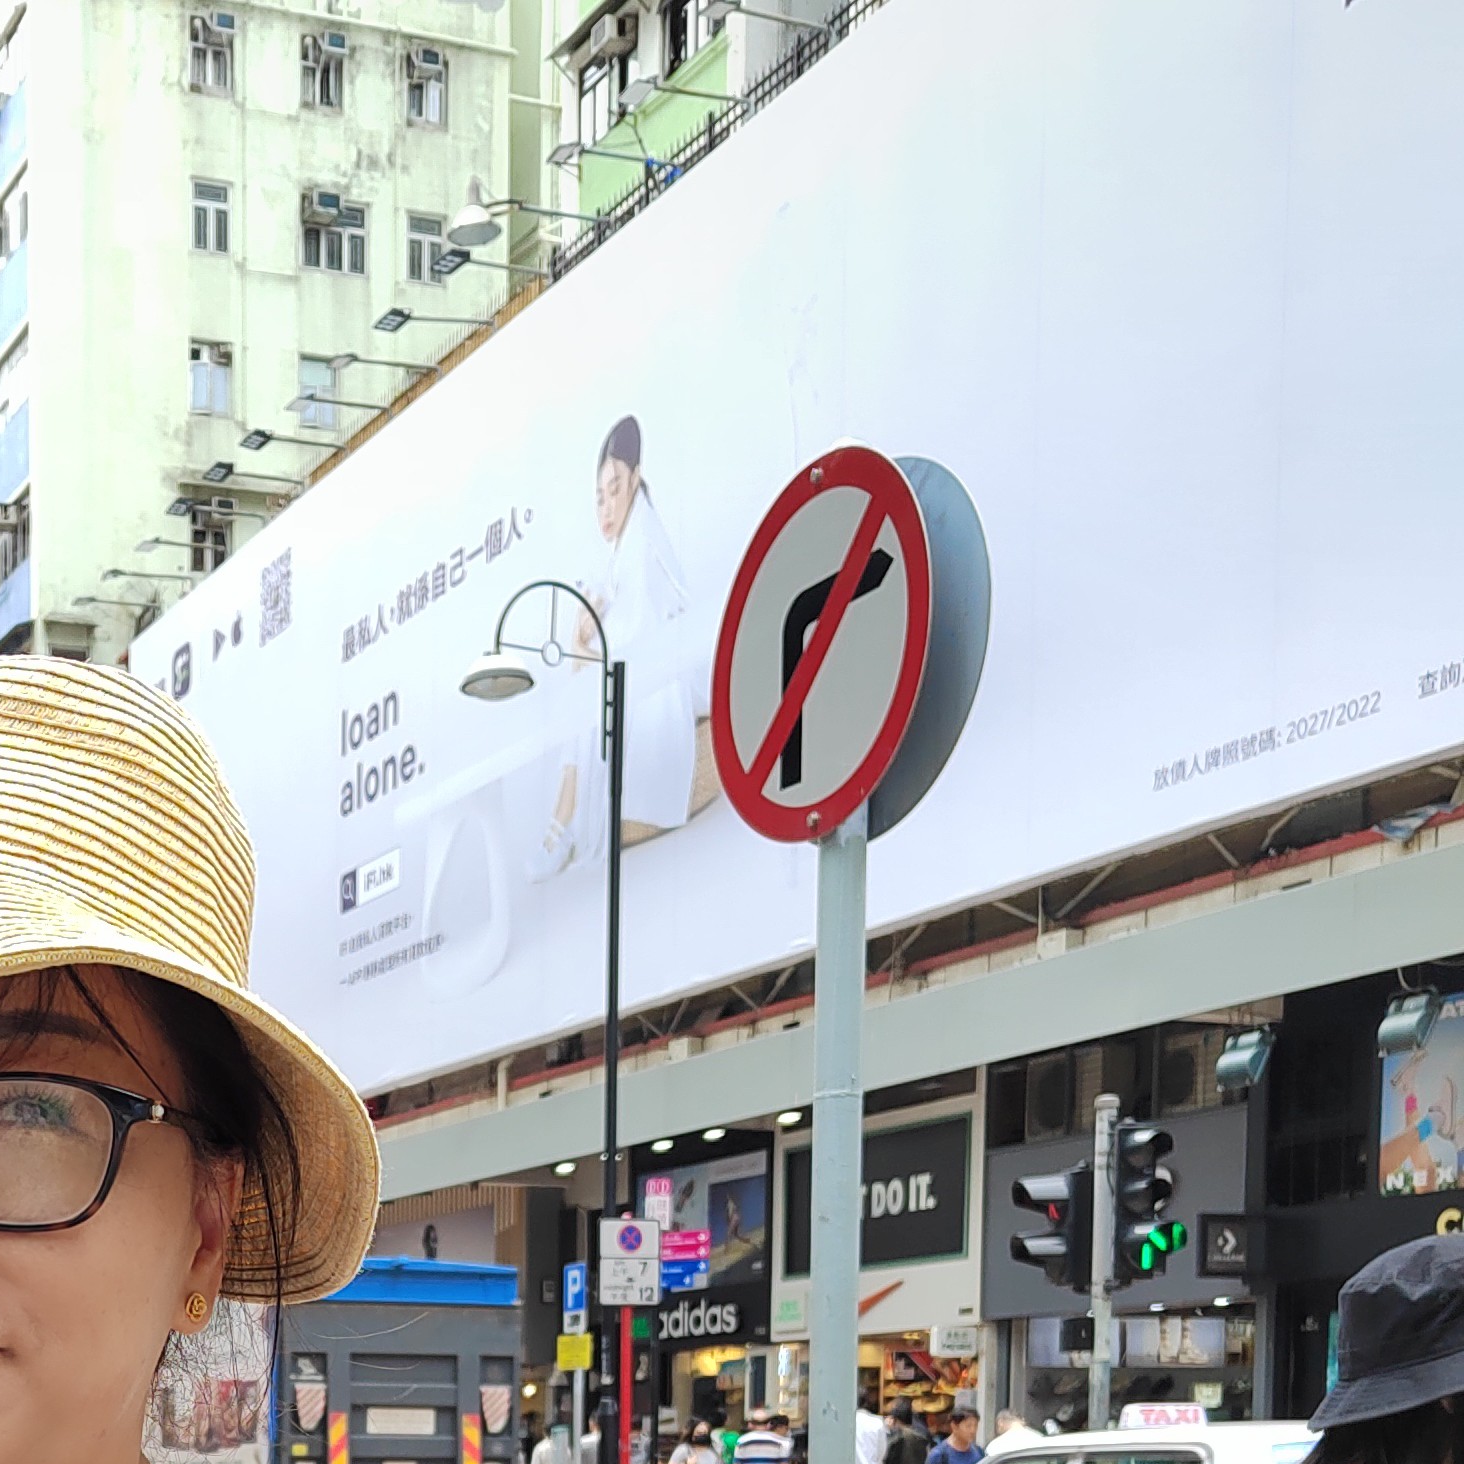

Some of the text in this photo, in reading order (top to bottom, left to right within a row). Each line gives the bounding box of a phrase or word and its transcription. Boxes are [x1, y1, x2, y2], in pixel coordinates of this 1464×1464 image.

[341, 690, 399, 757] loan
[1286, 690, 1382, 745] 2027/2022
[340, 744, 426, 818] alone.
[870, 1177, 904, 1218] DO
[908, 1171, 938, 1212] IT.
[567, 1269, 581, 1308] P
[639, 1261, 648, 1276] 7
[639, 1287, 654, 1301] 12
[1140, 1408, 1200, 1425] TAXI
